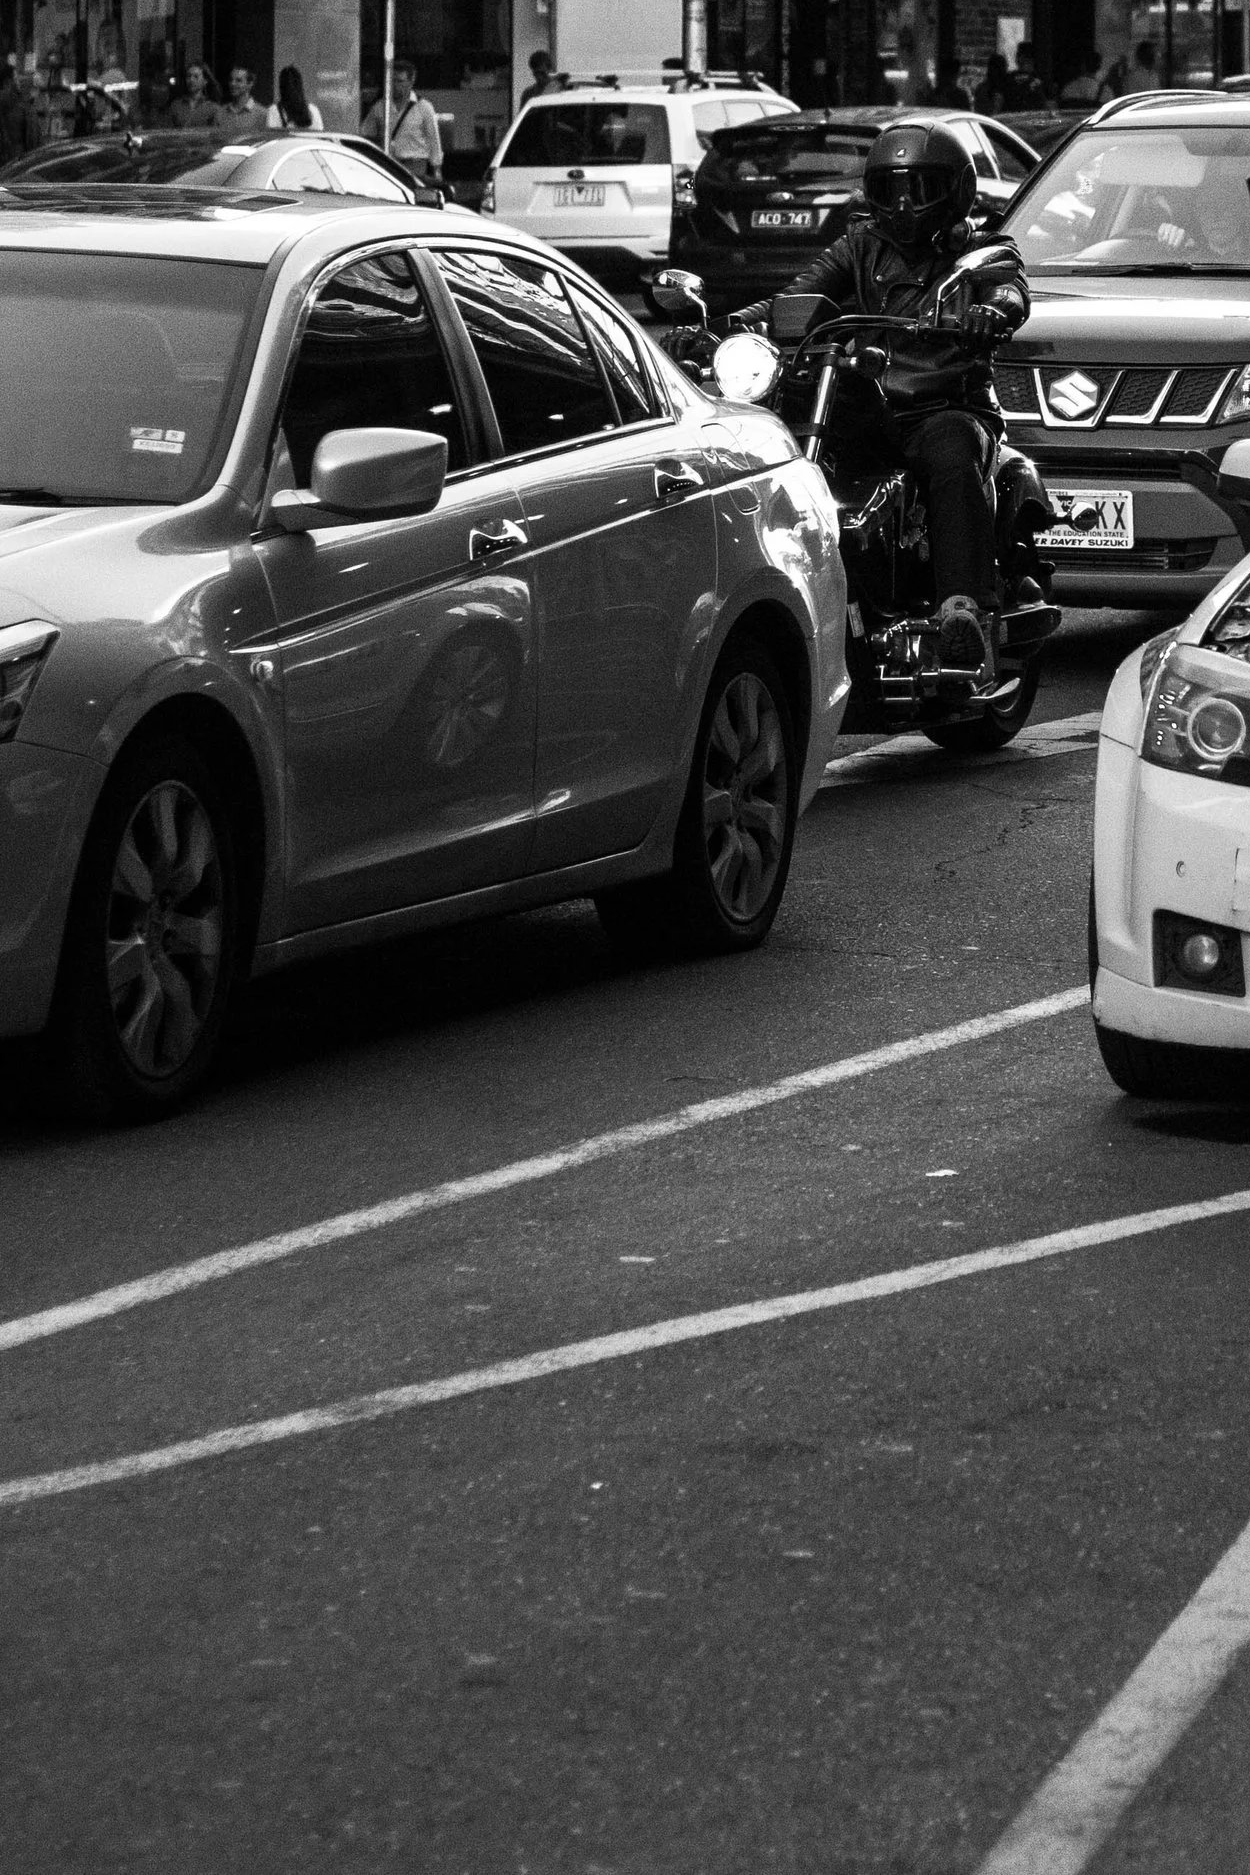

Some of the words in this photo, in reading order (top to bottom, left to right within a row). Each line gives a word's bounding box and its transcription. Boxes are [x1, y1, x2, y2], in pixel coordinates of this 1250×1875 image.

[1063, 530, 1102, 538] EDUCATION
[1050, 538, 1084, 546] DAVEY
[1088, 539, 1128, 547] SUZUKI
